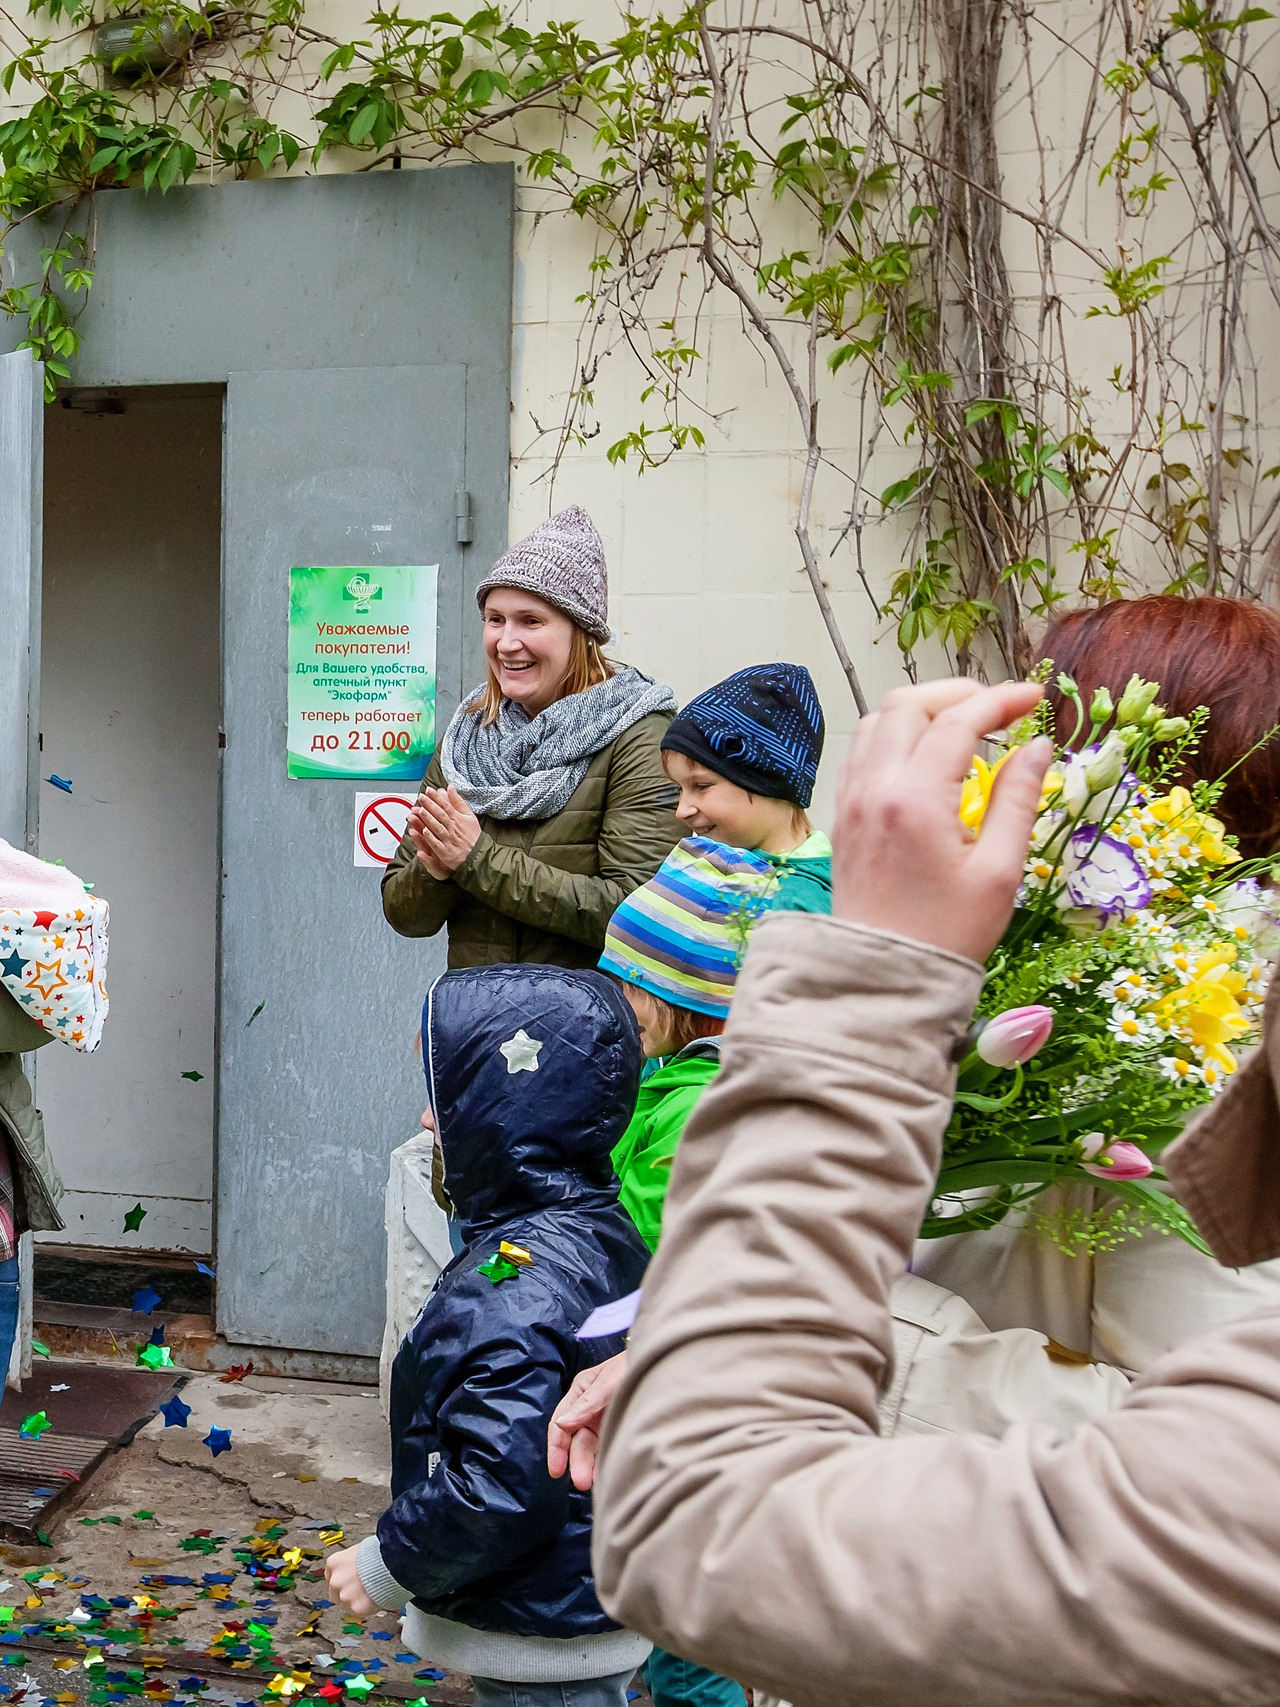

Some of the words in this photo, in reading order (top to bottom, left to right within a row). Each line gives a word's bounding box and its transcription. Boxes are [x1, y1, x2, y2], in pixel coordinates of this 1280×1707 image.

[316, 622, 410, 636] Уважаемые
[314, 641, 410, 658] покупатели!
[296, 662, 319, 675] Для
[322, 663, 367, 674] Вашего
[371, 662, 428, 676] удобства,
[312, 677, 370, 687] аптечный
[374, 678, 407, 689] пункт
[327, 690, 392, 703] "Экофарм"
[300, 711, 350, 724] теперь
[355, 709, 422, 725] работает
[310, 734, 339, 752] до
[347, 730, 411, 751] 21.00
